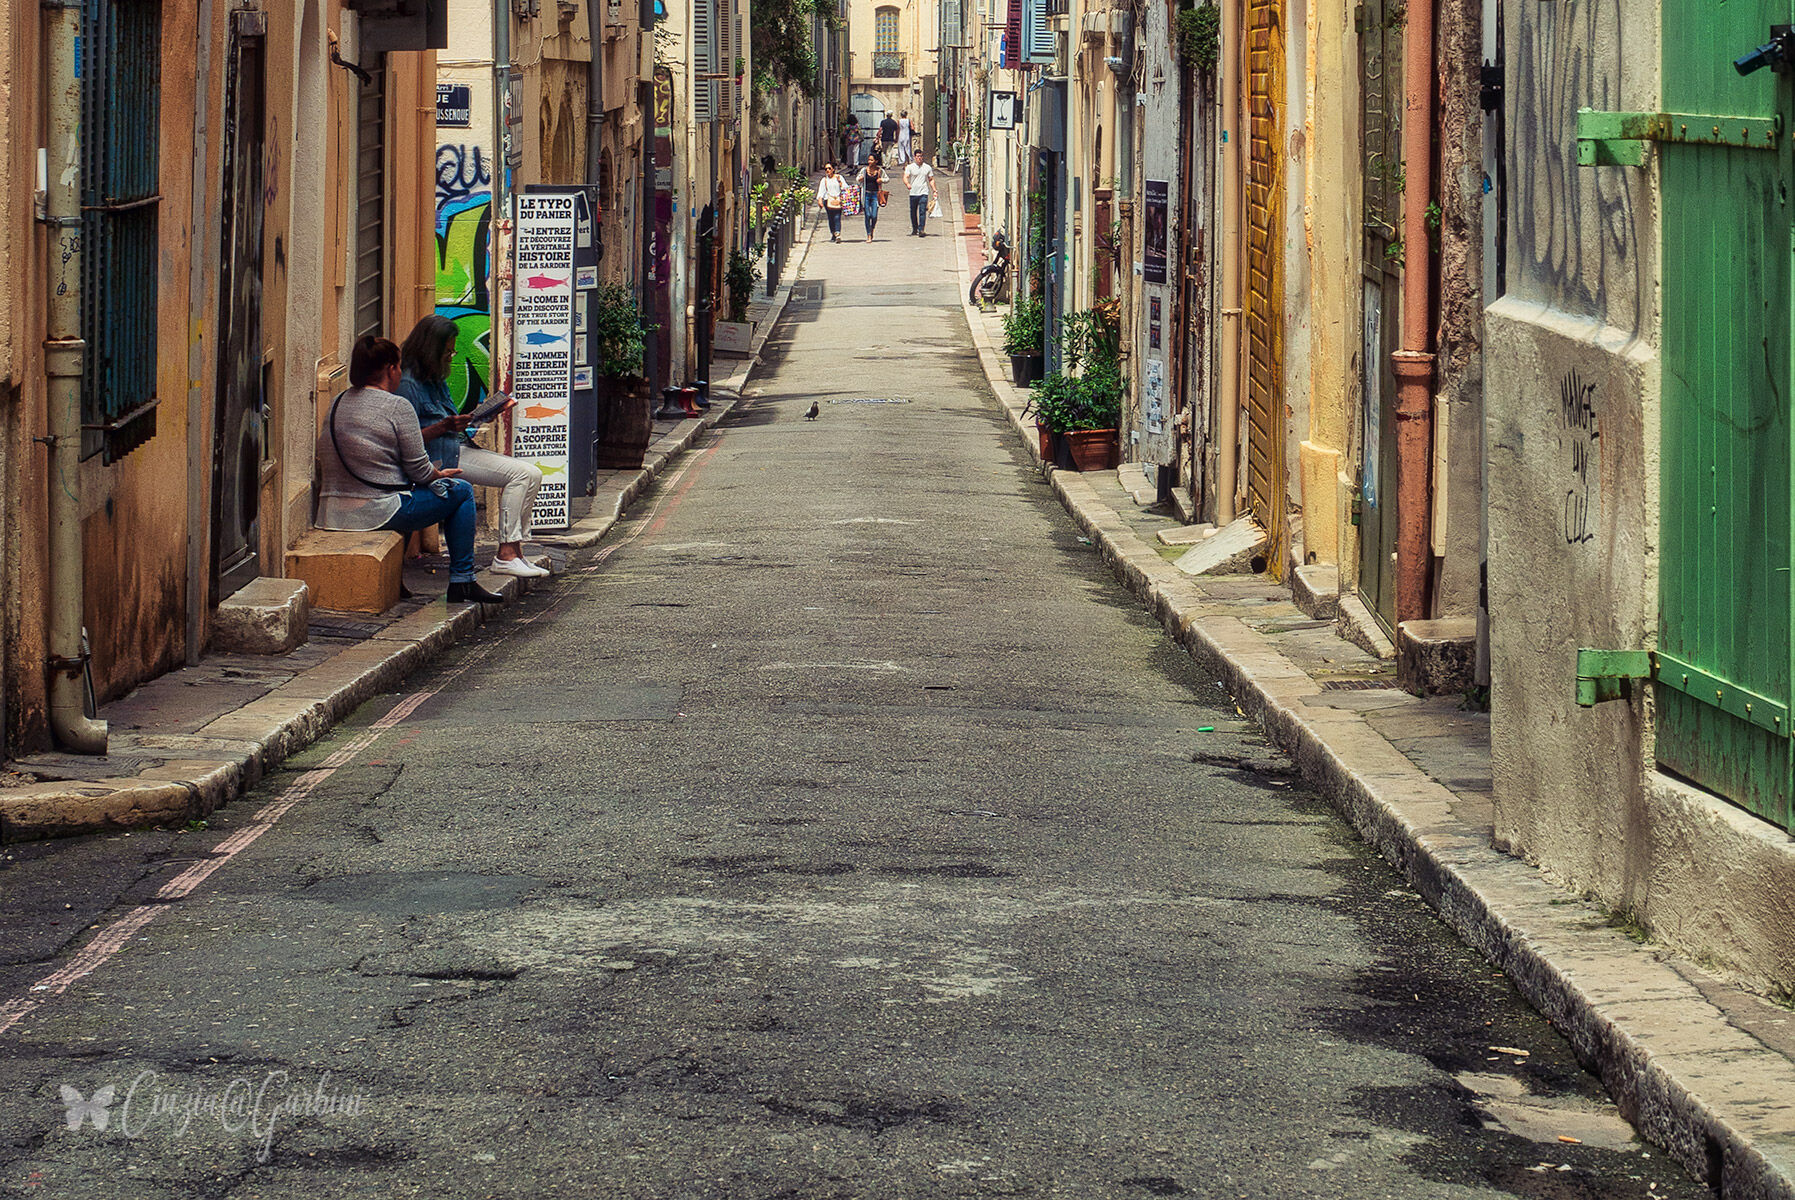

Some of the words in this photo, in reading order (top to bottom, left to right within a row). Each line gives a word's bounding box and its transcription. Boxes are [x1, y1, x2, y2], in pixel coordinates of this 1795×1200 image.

[436, 94, 449, 103] UE
[436, 109, 469, 120] USSENQUE
[521, 199, 536, 209] LE
[538, 199, 571, 209] TYPO
[521, 211, 534, 219] DU
[536, 211, 571, 219] PANIER
[520, 252, 570, 261] HISTOIRE
[533, 361, 568, 369] HEREIN
[516, 383, 567, 391] GESCHICHTE
[531, 425, 567, 433] ENTRATE
[523, 434, 566, 443] SCOPRIRE
[540, 483, 566, 491] TREN
[536, 492, 566, 500] CUBRAN
[532, 508, 565, 518] TORIA
[1565, 485, 1594, 544] CUL
